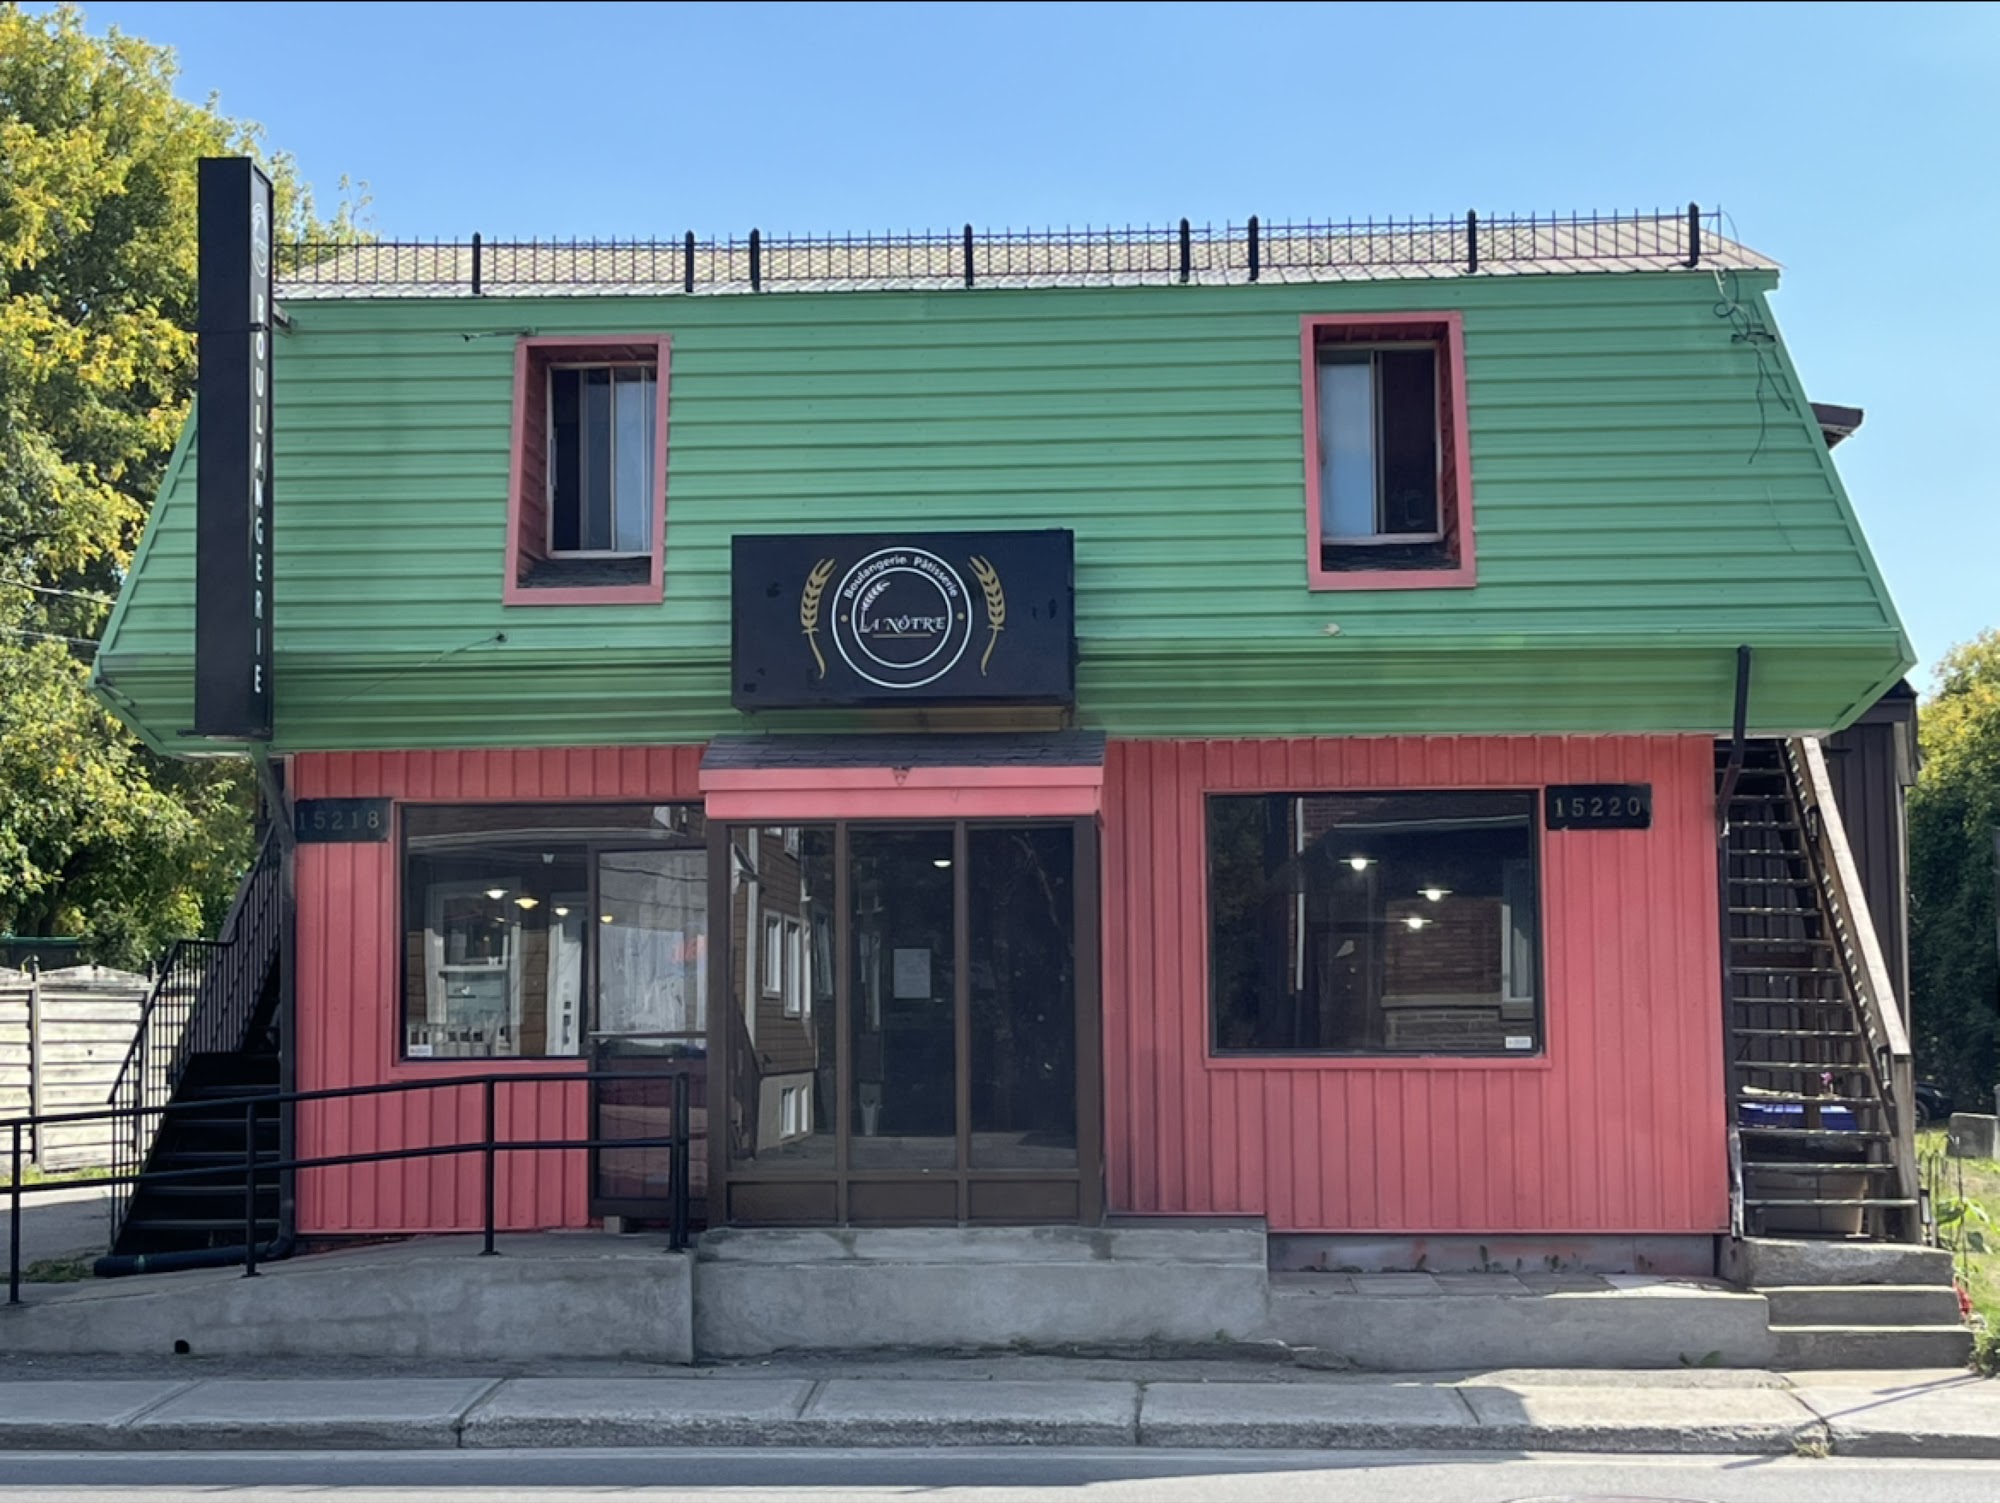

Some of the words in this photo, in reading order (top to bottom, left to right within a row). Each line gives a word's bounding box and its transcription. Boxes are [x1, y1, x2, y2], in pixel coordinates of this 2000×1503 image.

[254, 294, 265, 693] BOULANGERIE
[843, 555, 907, 600] Boulangerie
[299, 811, 379, 830] 15218
[1555, 797, 1641, 817] 15220
